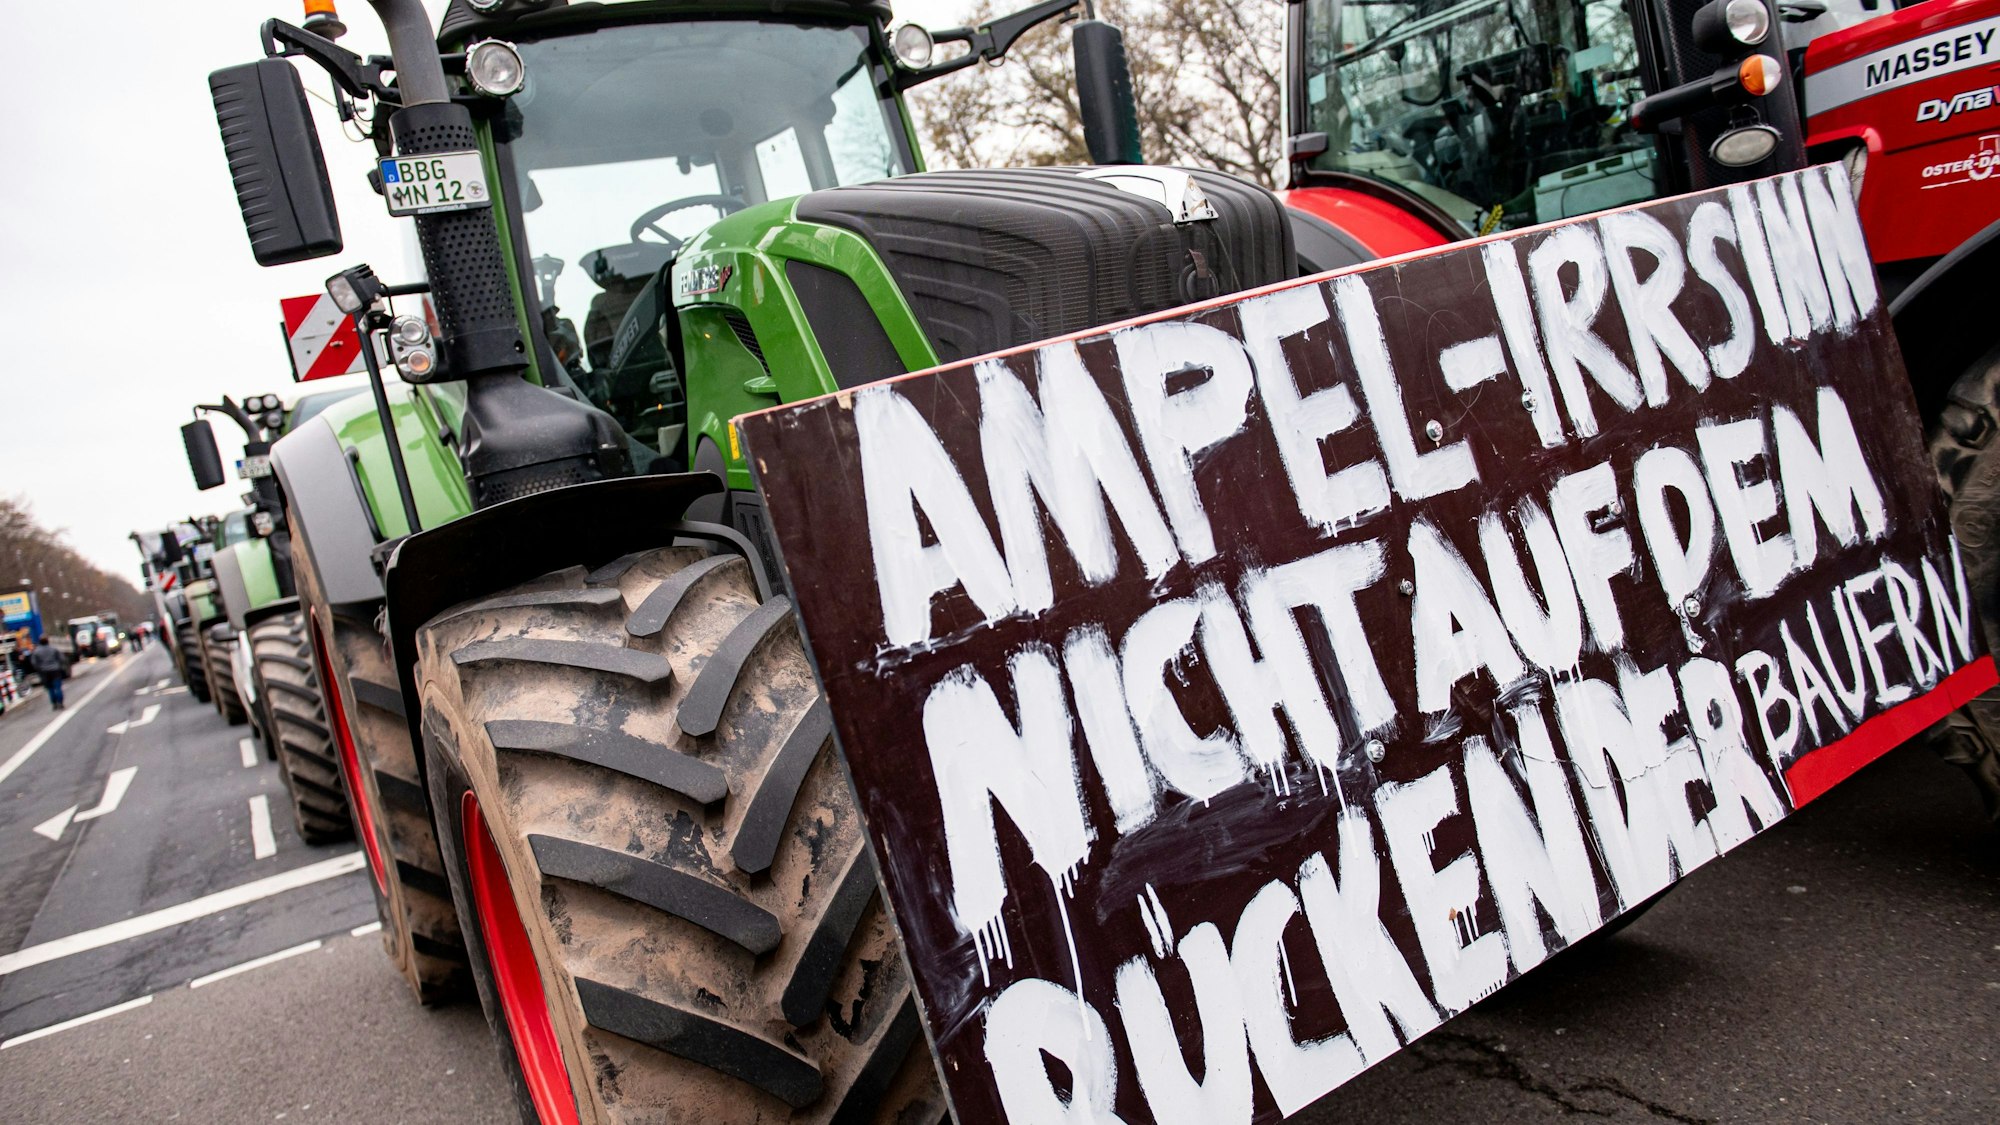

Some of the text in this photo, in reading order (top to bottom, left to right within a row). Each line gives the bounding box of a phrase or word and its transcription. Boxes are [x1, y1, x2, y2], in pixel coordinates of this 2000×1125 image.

[1866, 28, 1996, 88] MASSEY
[395, 180, 465, 207] MN 12
[398, 160, 446, 183] BBG
[853, 161, 1879, 652] AMPEL-IRRSINN
[922, 385, 1893, 945] NICHT AUF DEM
[1554, 656, 1793, 910] DER
[1735, 533, 1973, 768] BAUERN
